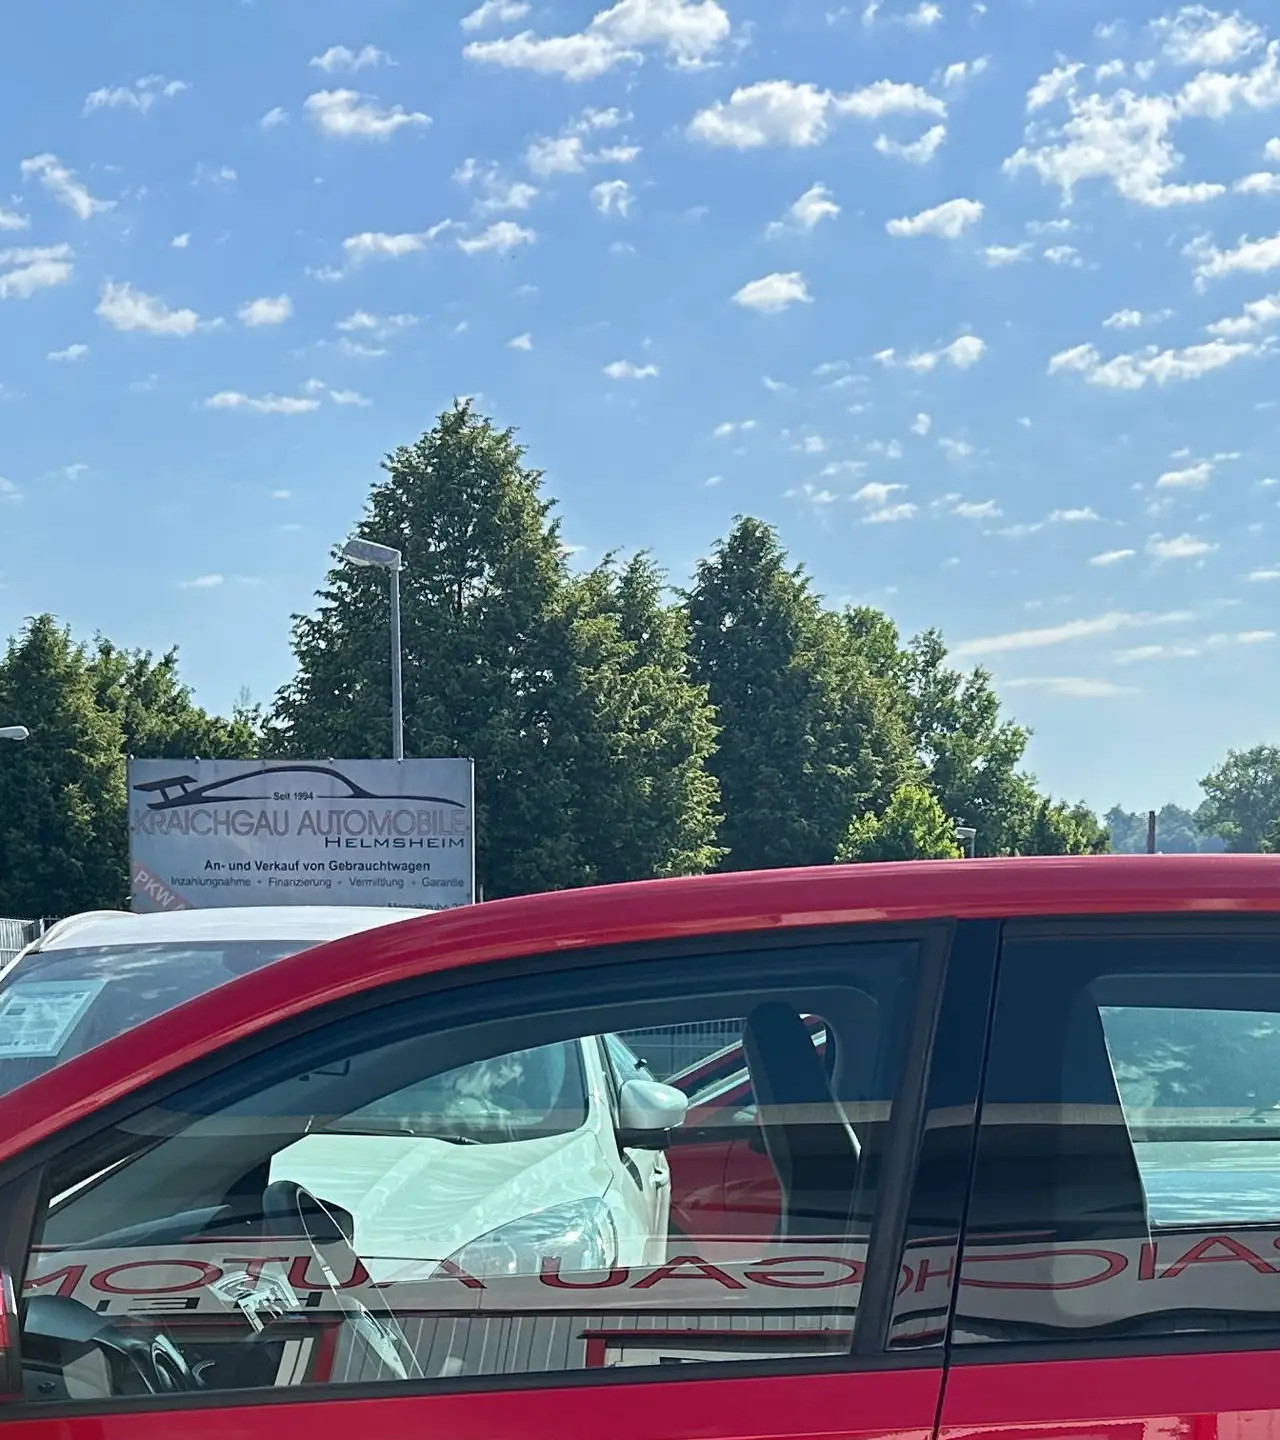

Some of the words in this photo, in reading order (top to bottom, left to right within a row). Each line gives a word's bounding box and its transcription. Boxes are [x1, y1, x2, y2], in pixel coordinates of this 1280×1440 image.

[273, 791, 290, 801] Seit
[293, 791, 314, 801] 1994
[134, 808, 290, 837] KRAICHGAU
[296, 808, 467, 837] AUTOMOBILE
[325, 837, 465, 849] HELMSHEIM
[204, 859, 225, 872] An-
[228, 860, 251, 872] und
[254, 860, 299, 872] Verkauf
[303, 862, 325, 872] von
[328, 860, 431, 874] Gebrauchtwagen
[133, 870, 174, 906] PKW
[269, 877, 332, 888] Finanzierung
[349, 877, 404, 889] Vermittlung
[421, 877, 464, 888] Garantie
